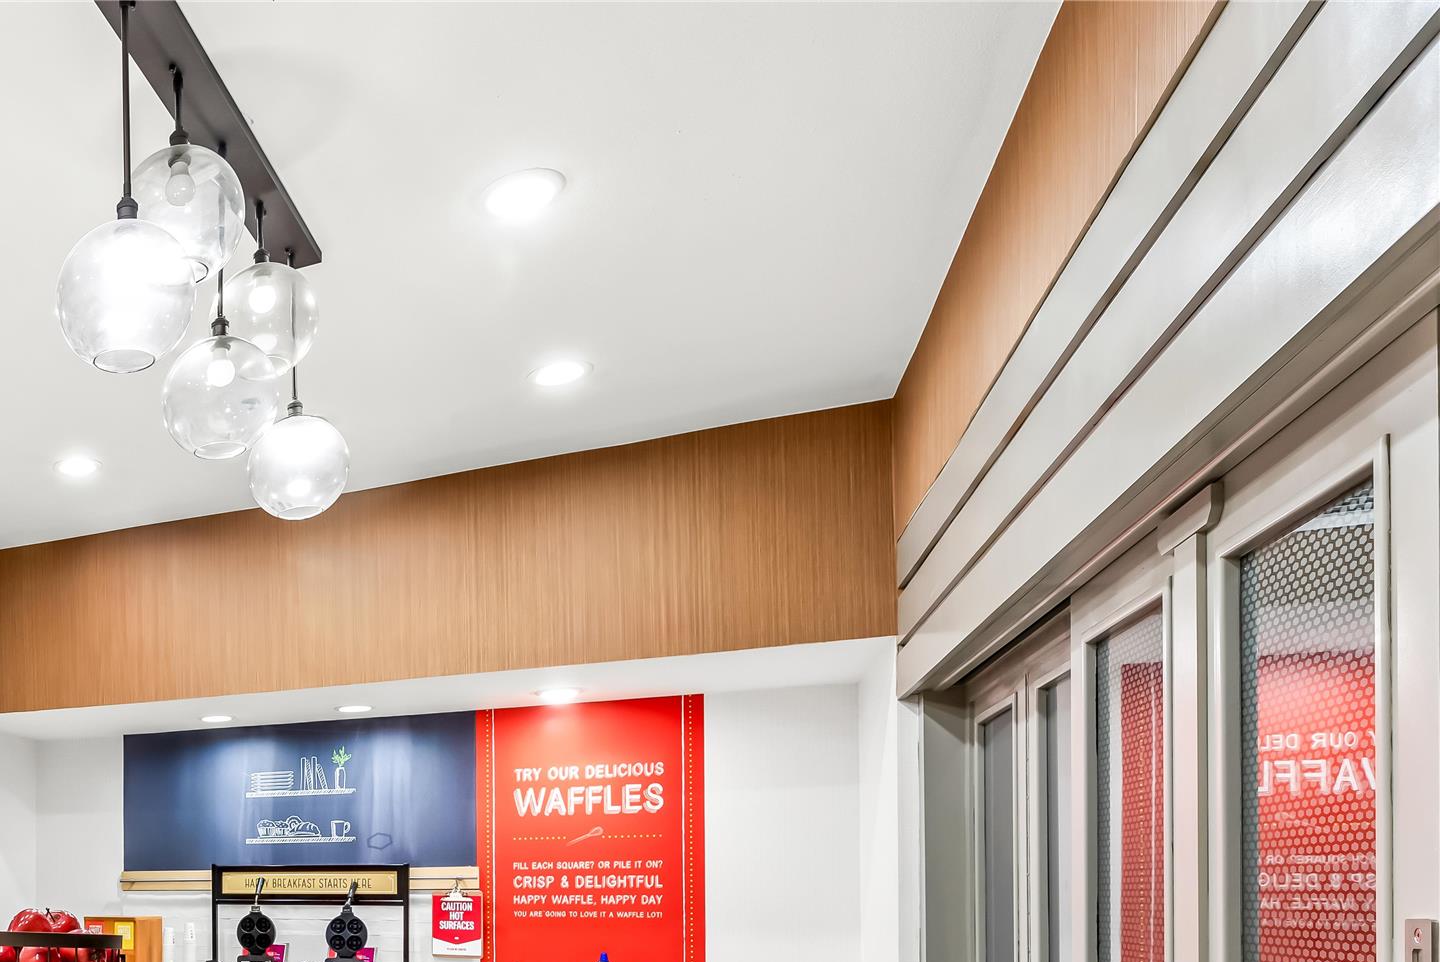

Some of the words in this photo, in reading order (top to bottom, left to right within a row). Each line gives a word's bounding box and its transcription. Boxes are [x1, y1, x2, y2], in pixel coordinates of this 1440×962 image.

[514, 768, 542, 782] TRY
[547, 766, 579, 780] OUR
[585, 762, 664, 779] DELICIOUS
[513, 783, 664, 817] WAFFLES
[513, 862, 528, 870] FILL
[532, 861, 553, 870] EACH
[556, 861, 594, 869] SQUARE?
[598, 861, 610, 869] OR
[613, 860, 631, 869] PILE
[634, 860, 642, 868] IT
[646, 860, 663, 868] ON?
[272, 878, 315, 888] BREAKFAST
[319, 878, 347, 888] STARTS
[513, 875, 554, 888] CRISP
[560, 875, 569, 888] &
[575, 875, 663, 888] DELIGHTFUL
[513, 895, 547, 904] HAPPY
[551, 895, 597, 905] WAFFLE,
[601, 895, 636, 904] HAPPY
[641, 895, 663, 904] DAY
[441, 902, 472, 911] CAUTION
[449, 912, 464, 920] HOT
[439, 920, 475, 930] SURFACES
